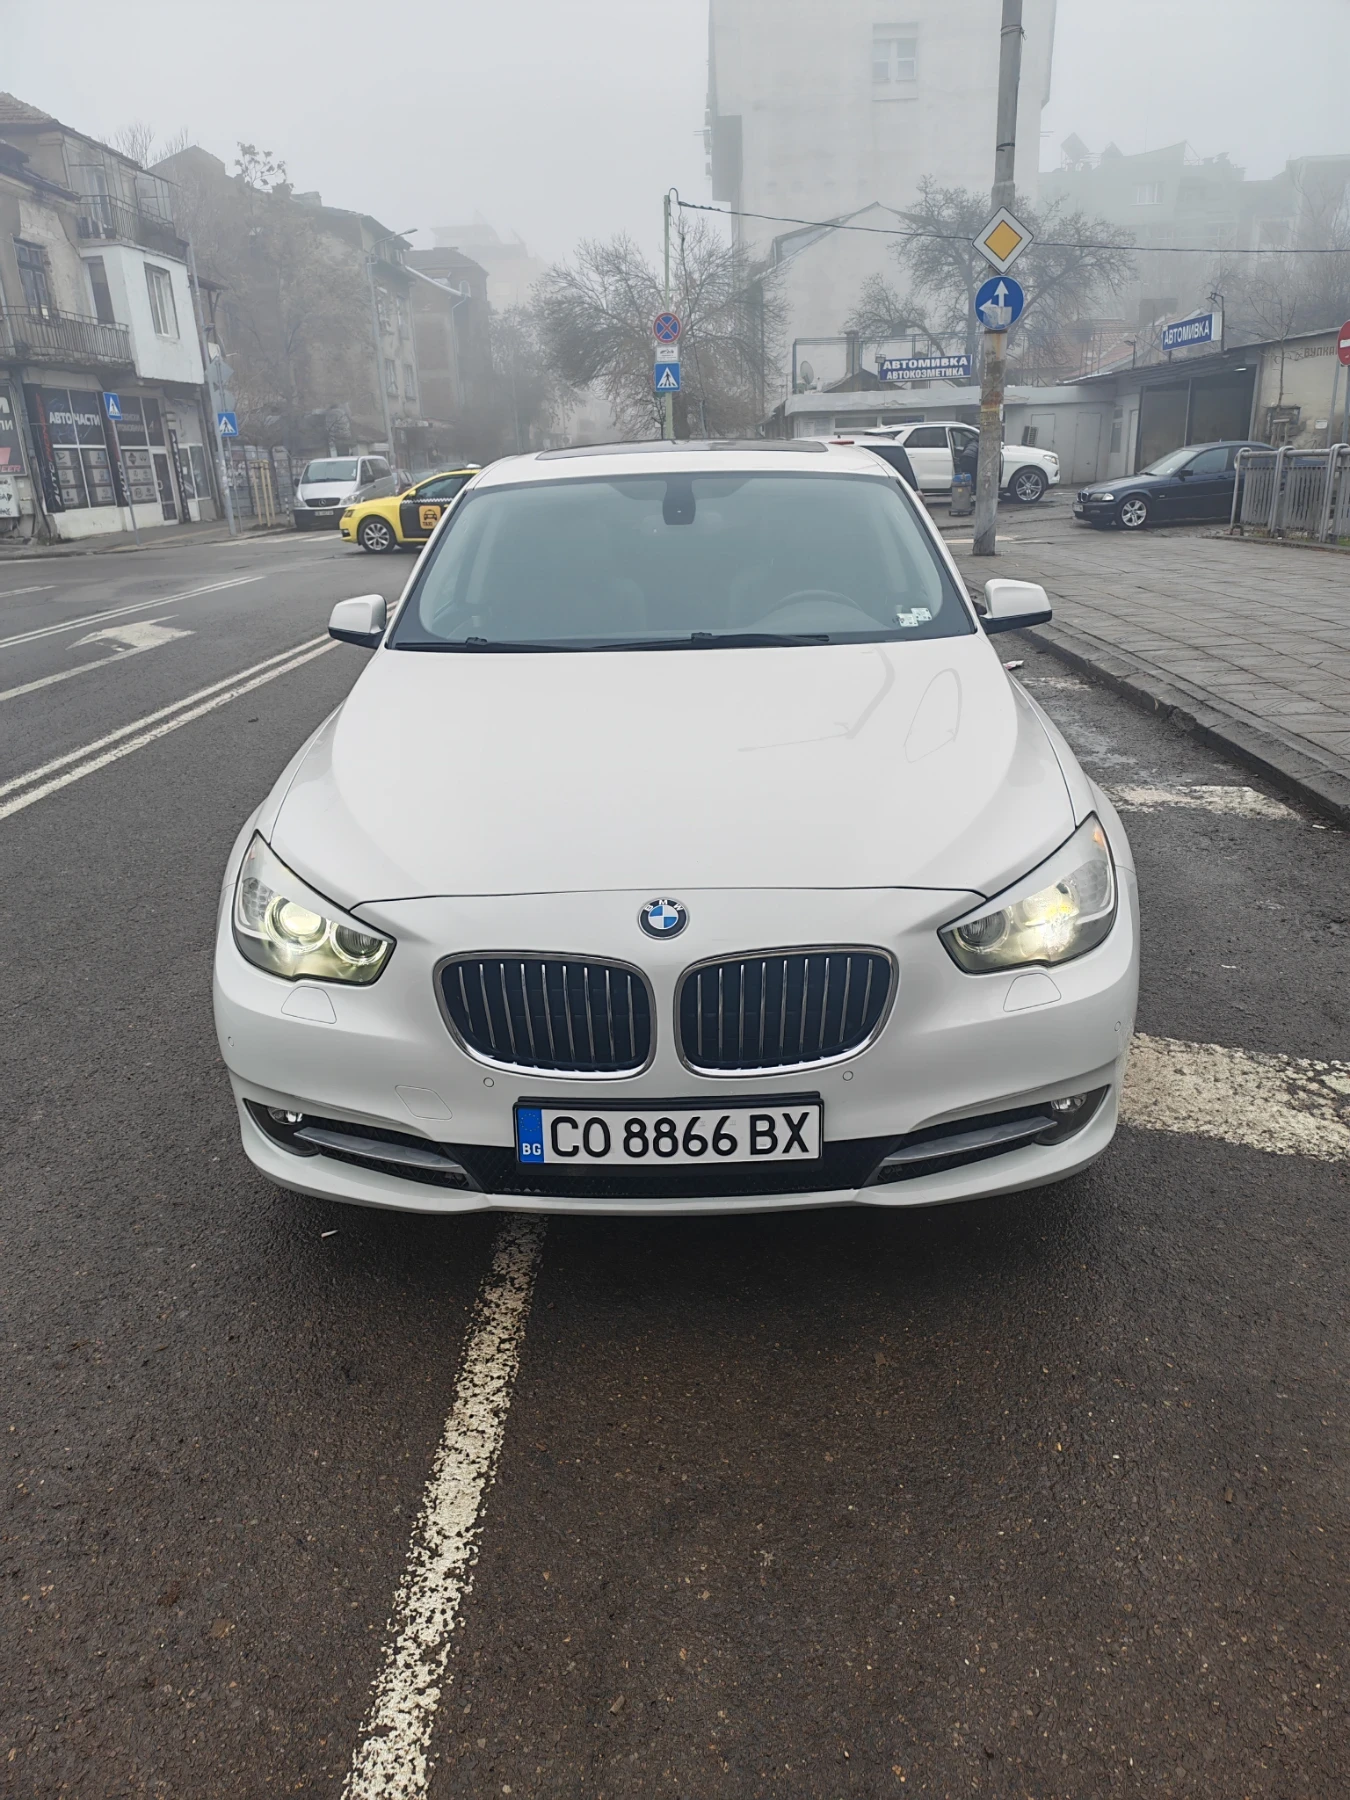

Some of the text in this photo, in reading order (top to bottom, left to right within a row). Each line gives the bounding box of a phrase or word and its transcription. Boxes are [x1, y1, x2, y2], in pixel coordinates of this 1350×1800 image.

[1164, 320, 1209, 344] АВТОМИВКА
[883, 357, 968, 369] АВТОМИВКА
[886, 367, 964, 380] АВТОКОЗМЕТИКА
[644, 899, 684, 911] BMW
[622, 1115, 738, 1157] 8866
[749, 1112, 810, 1155] BX
[522, 1142, 541, 1155] BG
